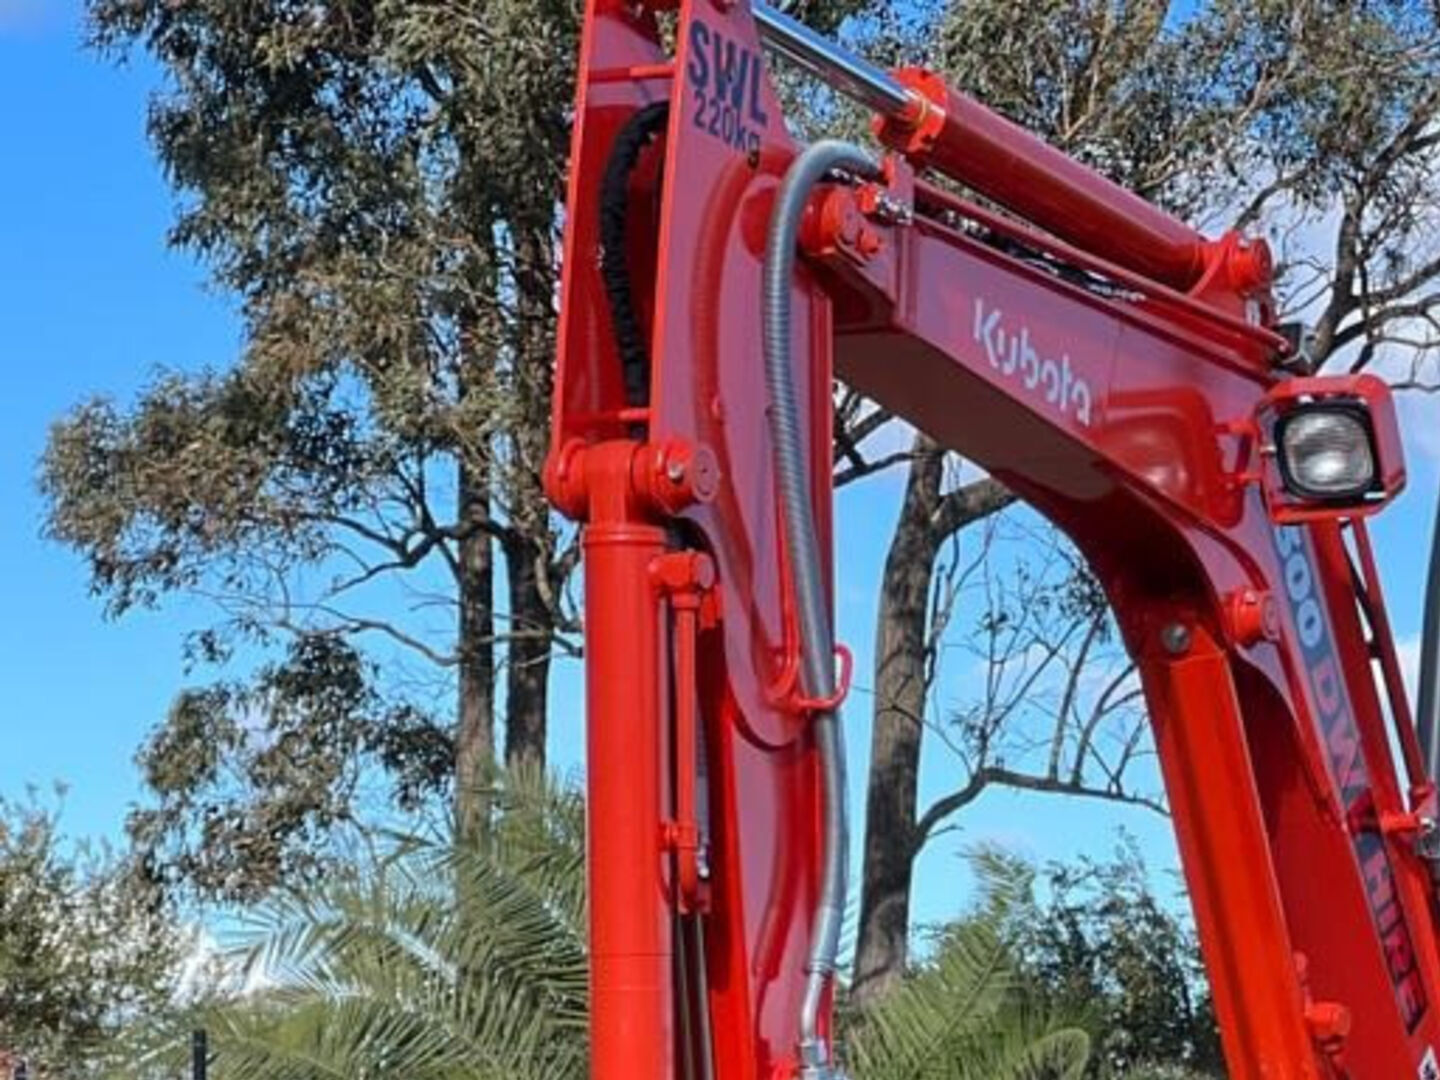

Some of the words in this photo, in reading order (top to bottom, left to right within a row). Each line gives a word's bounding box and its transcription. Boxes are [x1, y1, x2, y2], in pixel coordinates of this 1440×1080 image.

[688, 19, 768, 127] SWL
[973, 298, 1092, 427] Kubota
[1361, 850, 1426, 1032] HIRE
